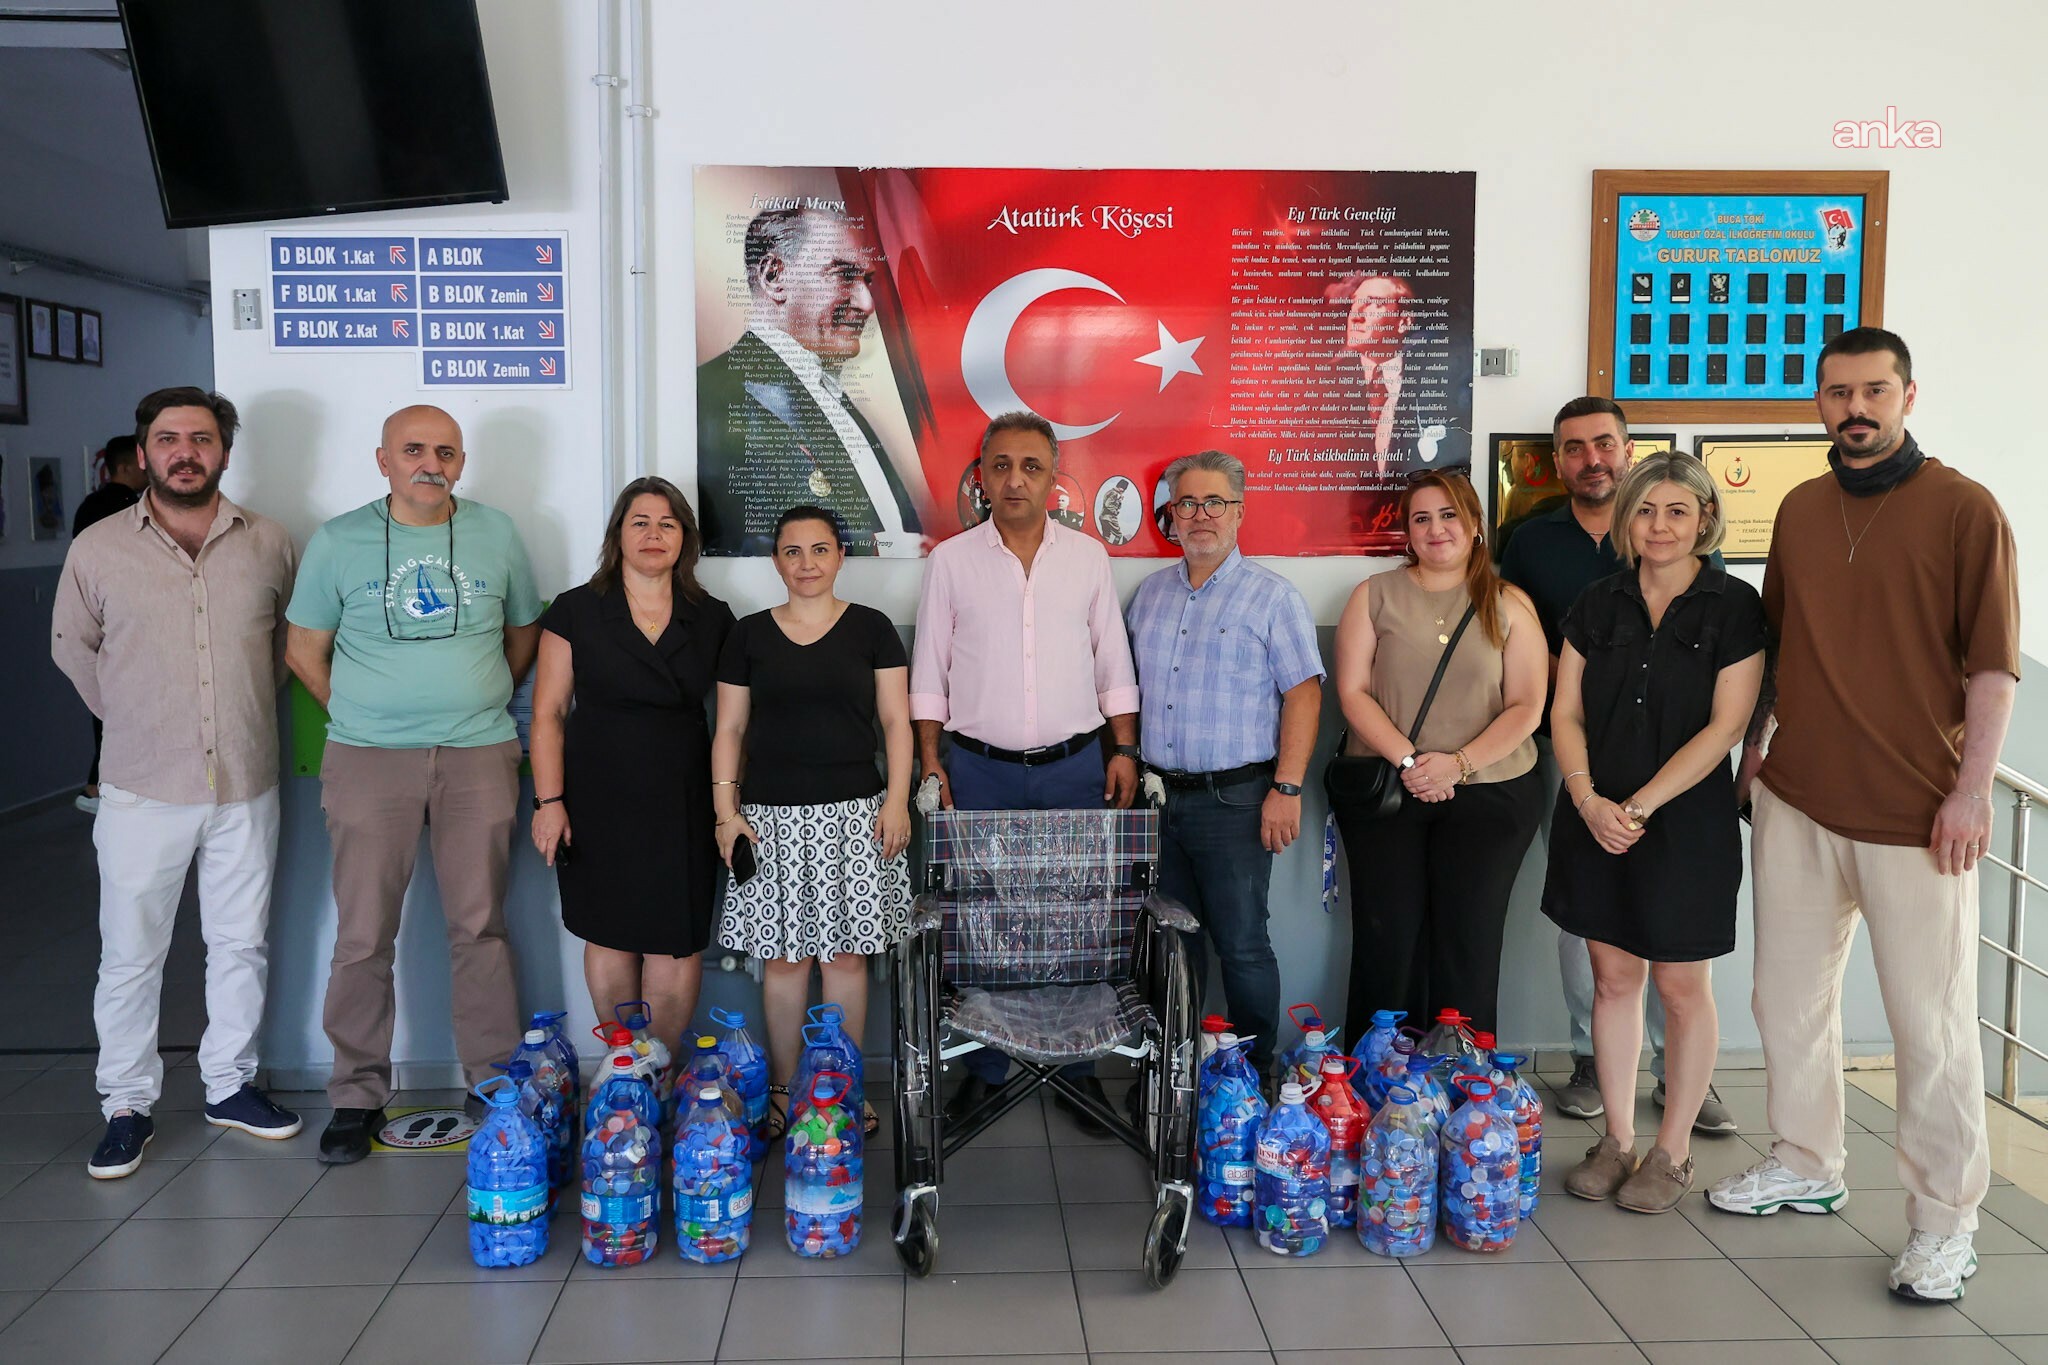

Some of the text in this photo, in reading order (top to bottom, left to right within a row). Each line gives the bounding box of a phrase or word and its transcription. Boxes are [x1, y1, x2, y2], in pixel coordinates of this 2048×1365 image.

[750, 193, 845, 212] İstiklal Marşı
[987, 205, 1173, 238] Atatürk Köşesi
[1288, 206, 1396, 223] Ey Türk Gençliği
[1717, 215, 1741, 224] BUCA
[1666, 228, 1815, 239] TURGUT ÖZAL İLKÖĞRETİM OKULU
[280, 247, 375, 265] D BLOK 1.Kat
[427, 248, 483, 265] A BLOK
[1657, 248, 1821, 263] GURUR TABLOMUZ
[281, 284, 376, 303] F BLOK 1.Kat
[429, 286, 528, 303] B BLOK Zemin
[282, 321, 378, 338] F BLOK 2.Kat
[430, 322, 524, 340] B BLOK 1.Kat
[431, 359, 530, 377] C BLOK Zemin
[1268, 448, 1282, 464] Ey
[1286, 448, 1310, 461] Türk
[1313, 448, 1369, 461] istikbalinin
[1373, 448, 1403, 461] evladı
[386, 558, 417, 608] SAILING
[426, 555, 472, 606] CALENDAR
